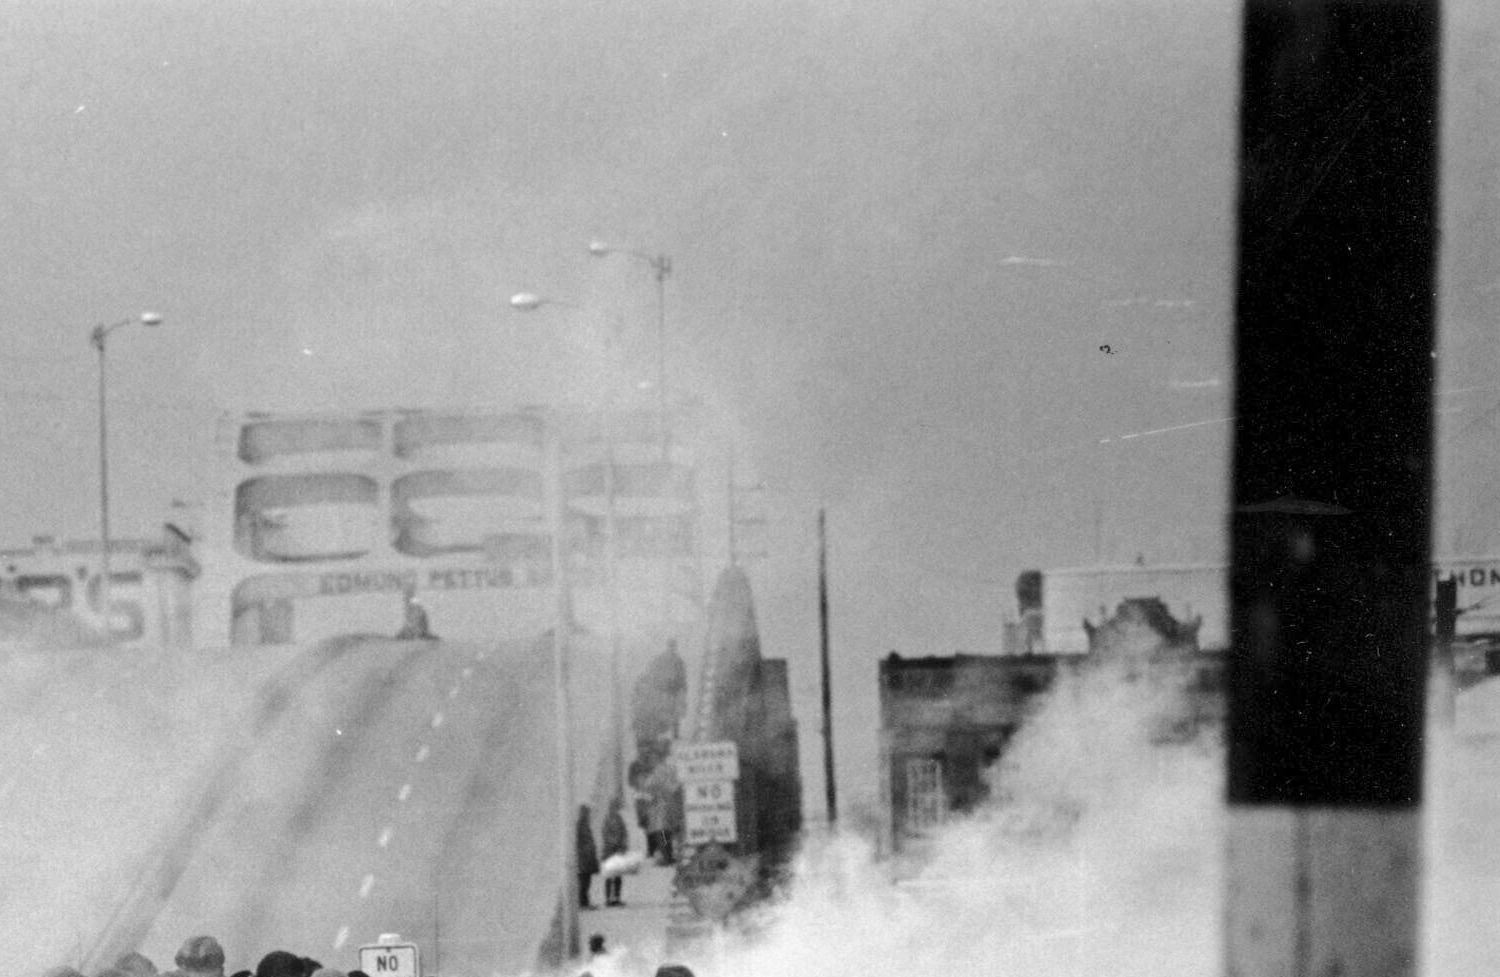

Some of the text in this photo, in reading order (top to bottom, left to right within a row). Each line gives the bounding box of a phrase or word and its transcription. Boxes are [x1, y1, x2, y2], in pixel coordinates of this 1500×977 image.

[429, 568, 513, 590] PETTUS
[697, 784, 721, 799] NO
[377, 956, 398, 971] NO
